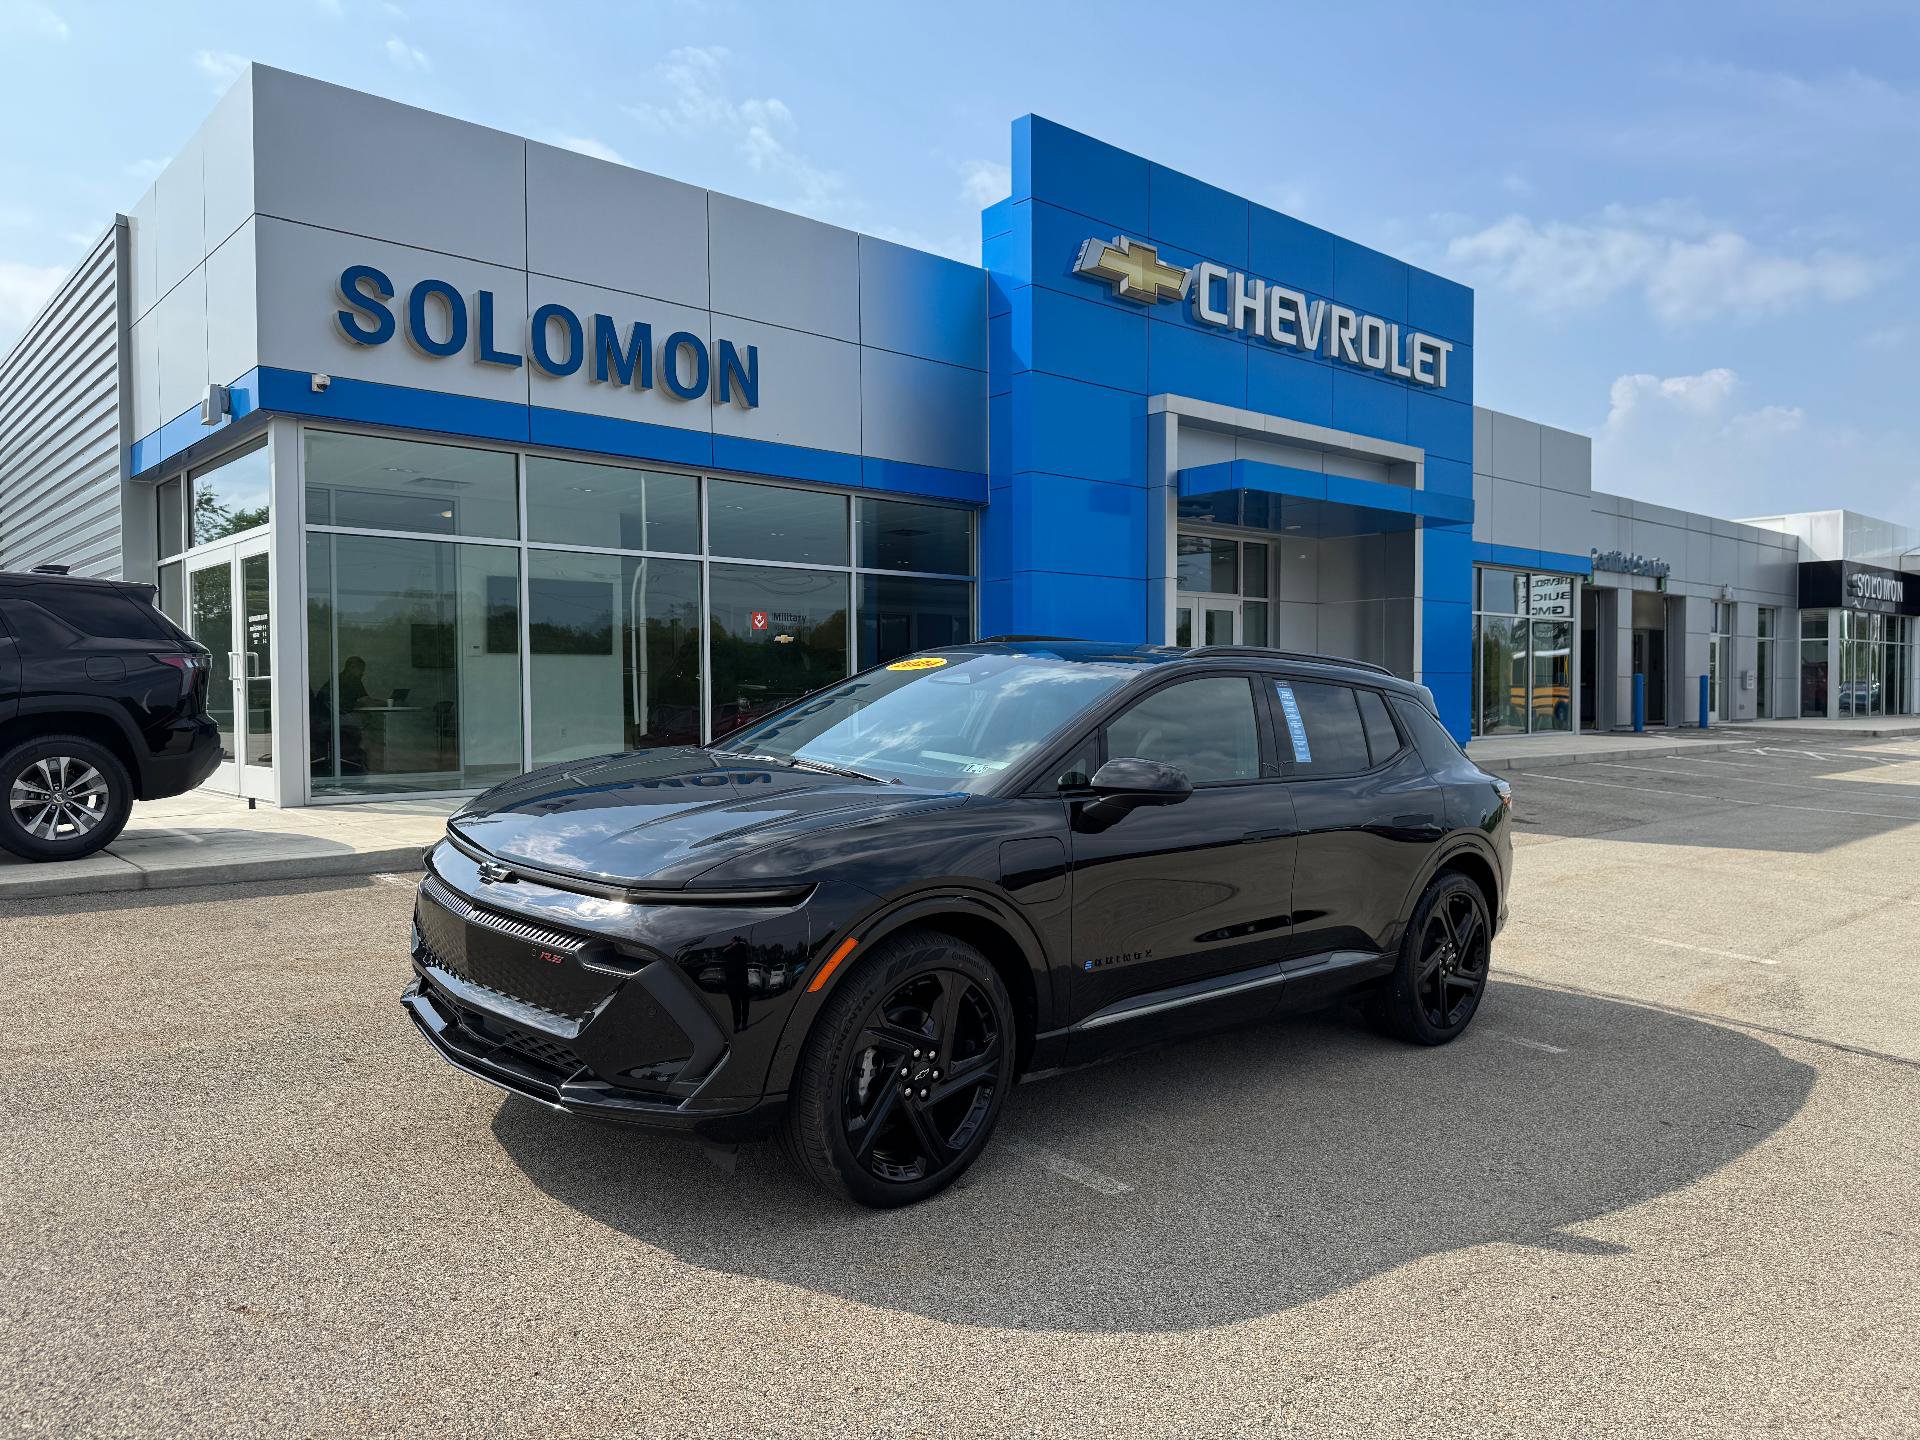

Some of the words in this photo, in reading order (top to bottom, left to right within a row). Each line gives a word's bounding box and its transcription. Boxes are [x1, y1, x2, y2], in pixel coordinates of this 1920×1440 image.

[335, 265, 759, 408] SOLOMON
[1192, 261, 1453, 388] CHEVROLET
[773, 612, 807, 623] Military
[1857, 573, 1903, 602] SOLOMON
